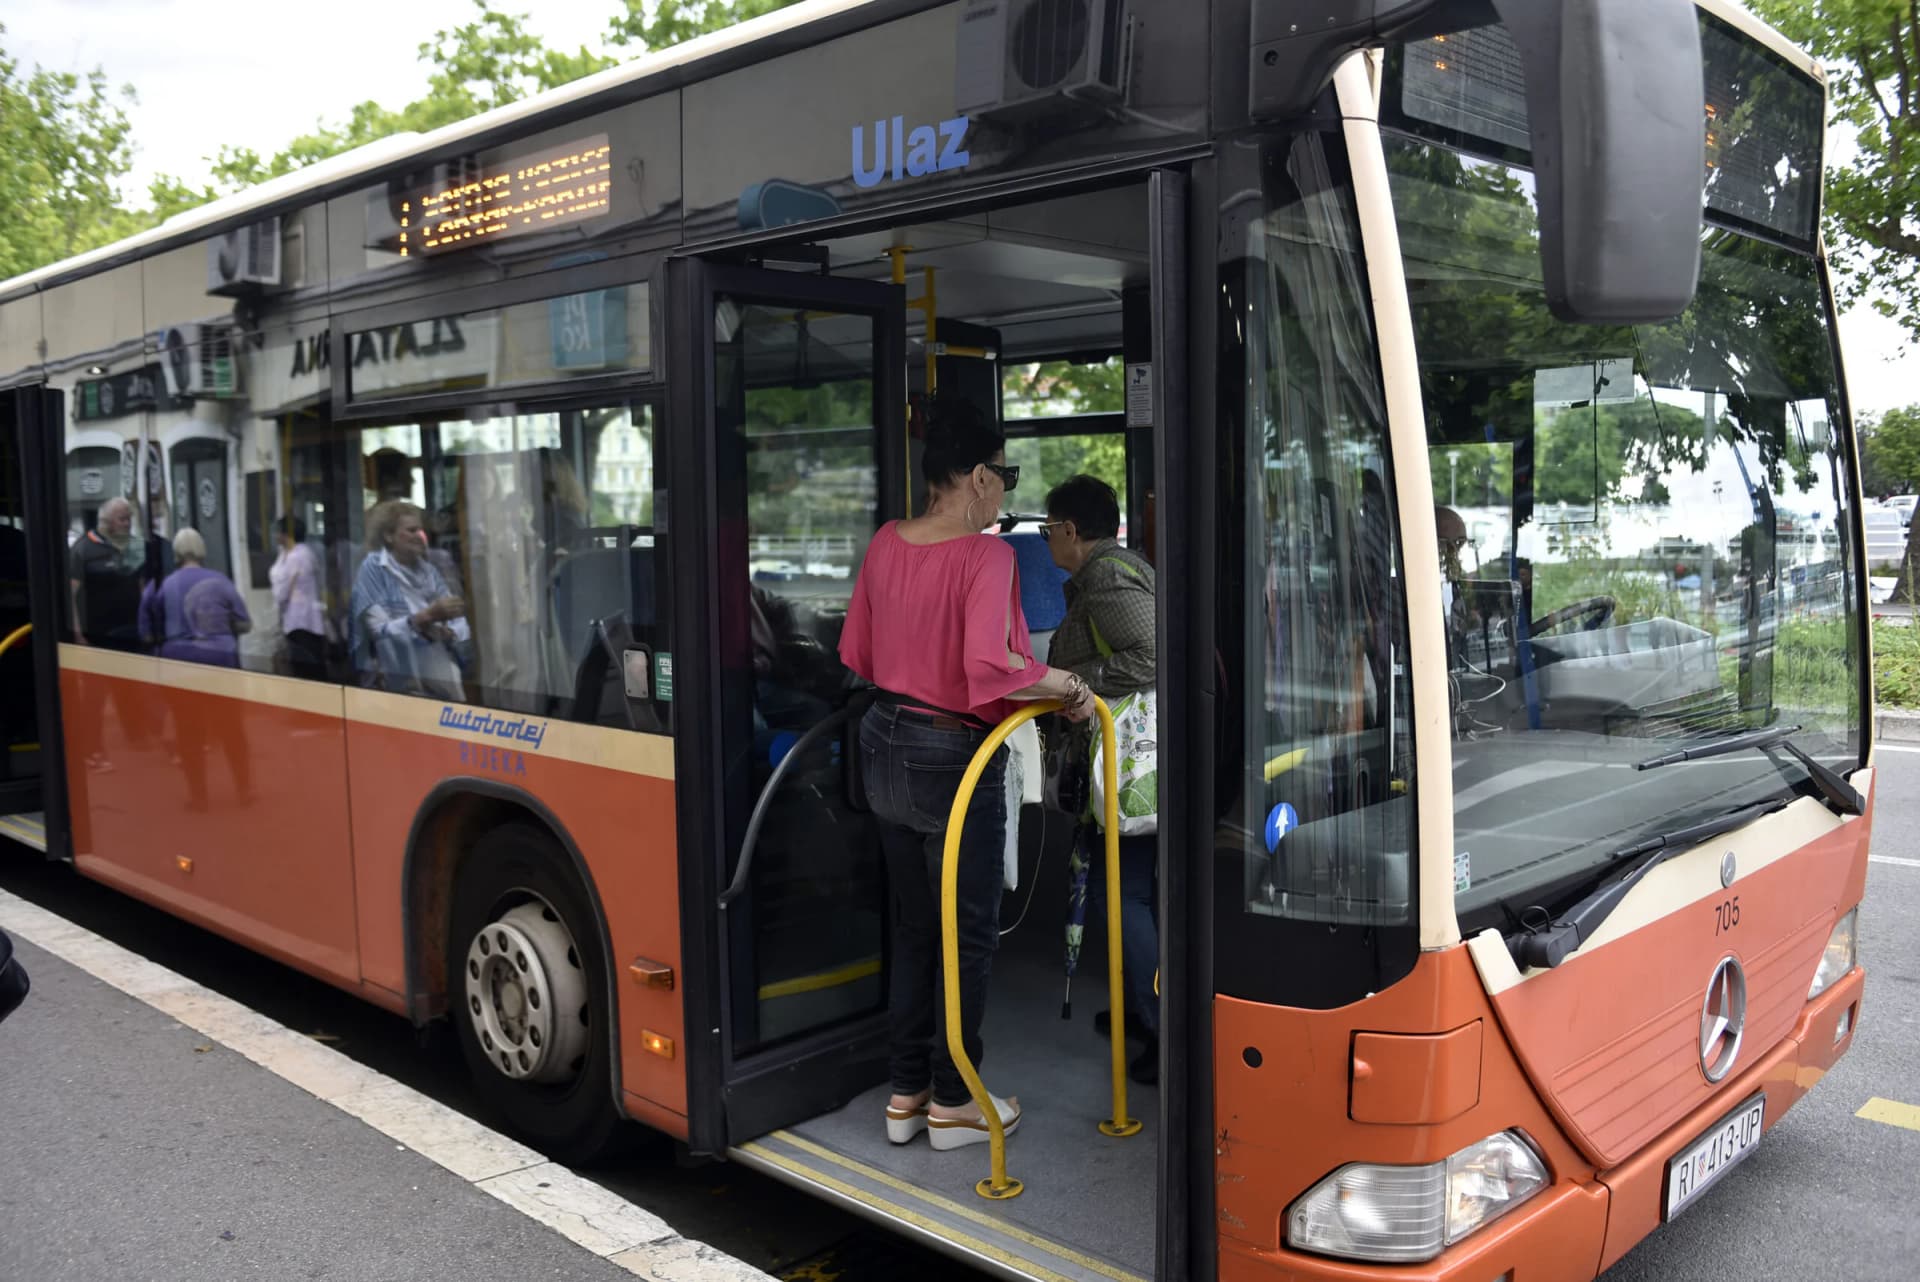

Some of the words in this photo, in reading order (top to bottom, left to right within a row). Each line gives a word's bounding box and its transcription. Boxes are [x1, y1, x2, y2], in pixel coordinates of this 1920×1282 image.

[852, 115, 970, 188] Ulaz
[459, 741, 528, 776] RIJEKA
[1715, 895, 1741, 937] 705
[1679, 1156, 1696, 1201] RI
[1708, 1108, 1760, 1173] 413-UP
